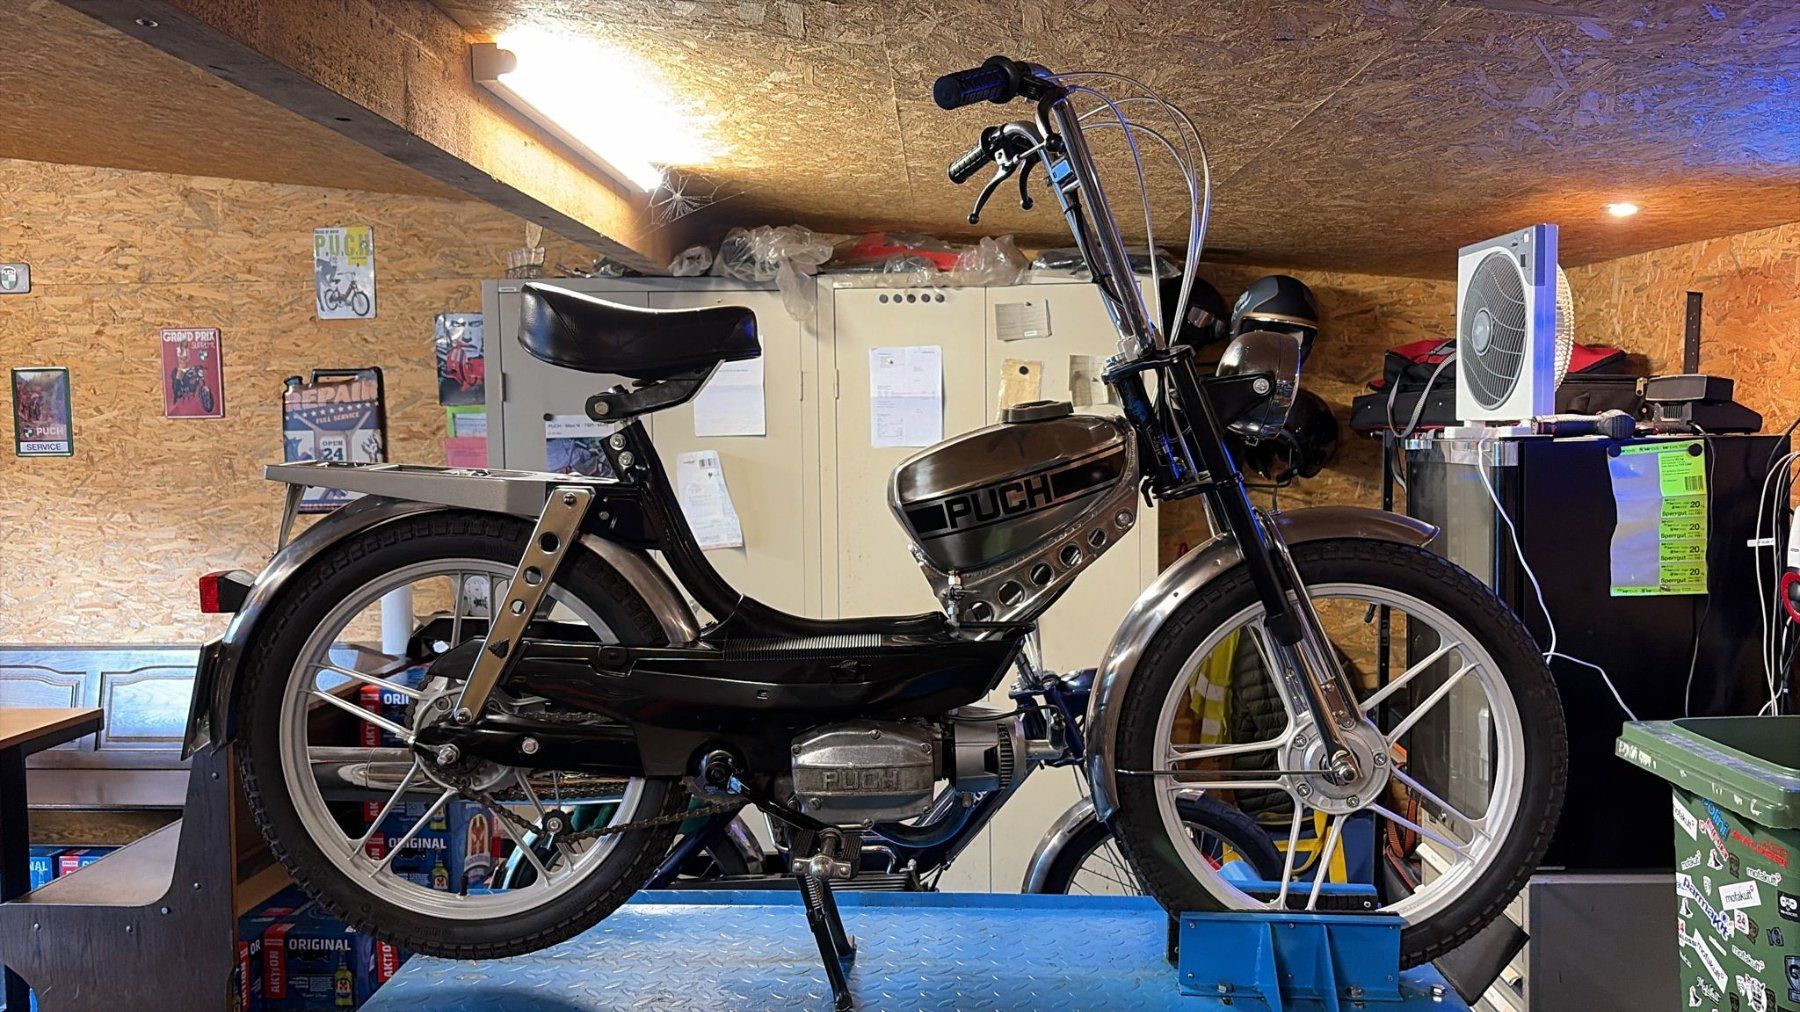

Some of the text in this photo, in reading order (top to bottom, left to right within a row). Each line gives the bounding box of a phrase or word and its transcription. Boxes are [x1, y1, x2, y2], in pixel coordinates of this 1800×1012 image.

[194, 331, 215, 342] PRIX
[334, 411, 360, 422] SERVICE
[36, 426, 65, 436] PUCH
[26, 443, 61, 451] SERVICE
[323, 448, 343, 461] 24
[944, 473, 1054, 530] PUCH
[822, 768, 899, 791] PUCH
[289, 938, 351, 951] ORIGINAL
[269, 950, 281, 993] AKTION
